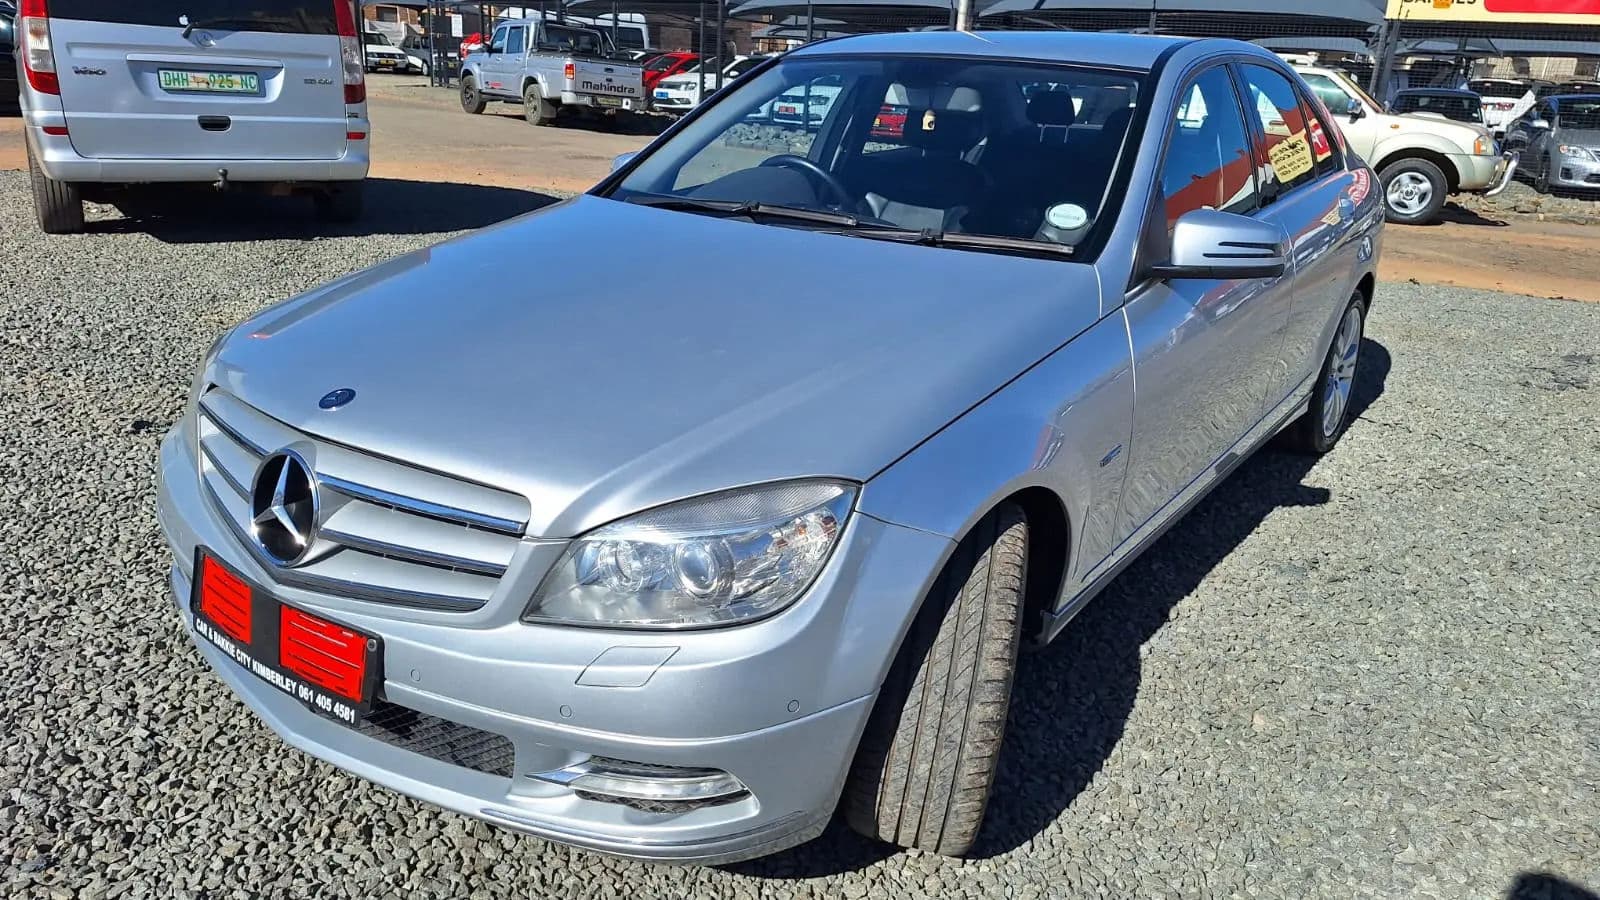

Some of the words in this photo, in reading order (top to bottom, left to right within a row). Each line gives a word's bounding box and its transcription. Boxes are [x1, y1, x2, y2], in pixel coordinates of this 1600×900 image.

[163, 71, 190, 86] DHH
[208, 73, 234, 89] 925
[240, 75, 257, 89] NC
[582, 81, 635, 94] Mahindra
[196, 618, 208, 637] CAR
[208, 627, 214, 641] &
[213, 630, 236, 658] BAKKIE
[235, 648, 252, 669] CITY
[252, 658, 298, 695] KIMBERLEY
[299, 684, 315, 704] 061
[315, 693, 333, 713] 405
[333, 701, 356, 724] 4581
